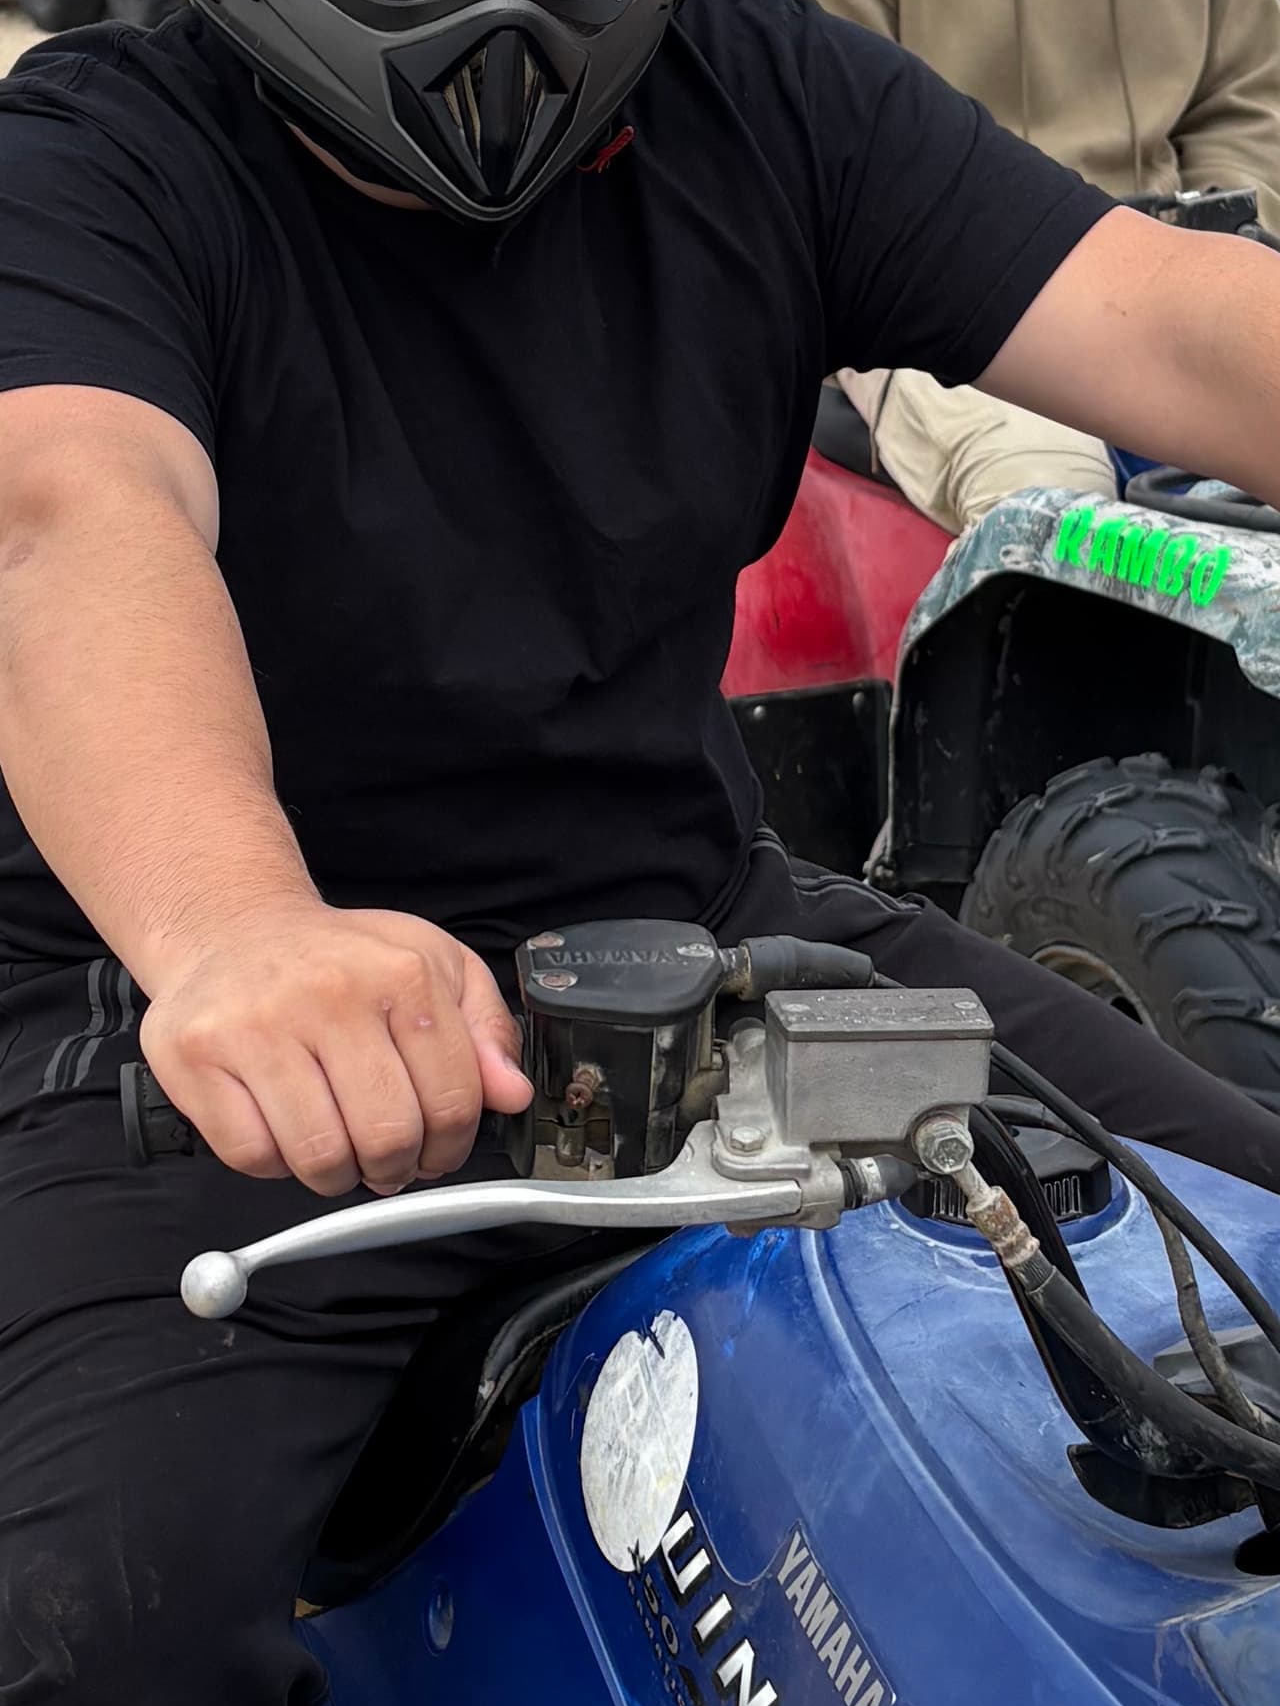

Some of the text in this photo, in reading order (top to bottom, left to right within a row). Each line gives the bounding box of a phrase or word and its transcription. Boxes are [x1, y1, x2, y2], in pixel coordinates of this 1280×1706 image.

[1053, 504, 1232, 608] RAMBO
[544, 948, 681, 966] YAMAHA
[637, 1557, 680, 1657] 50
